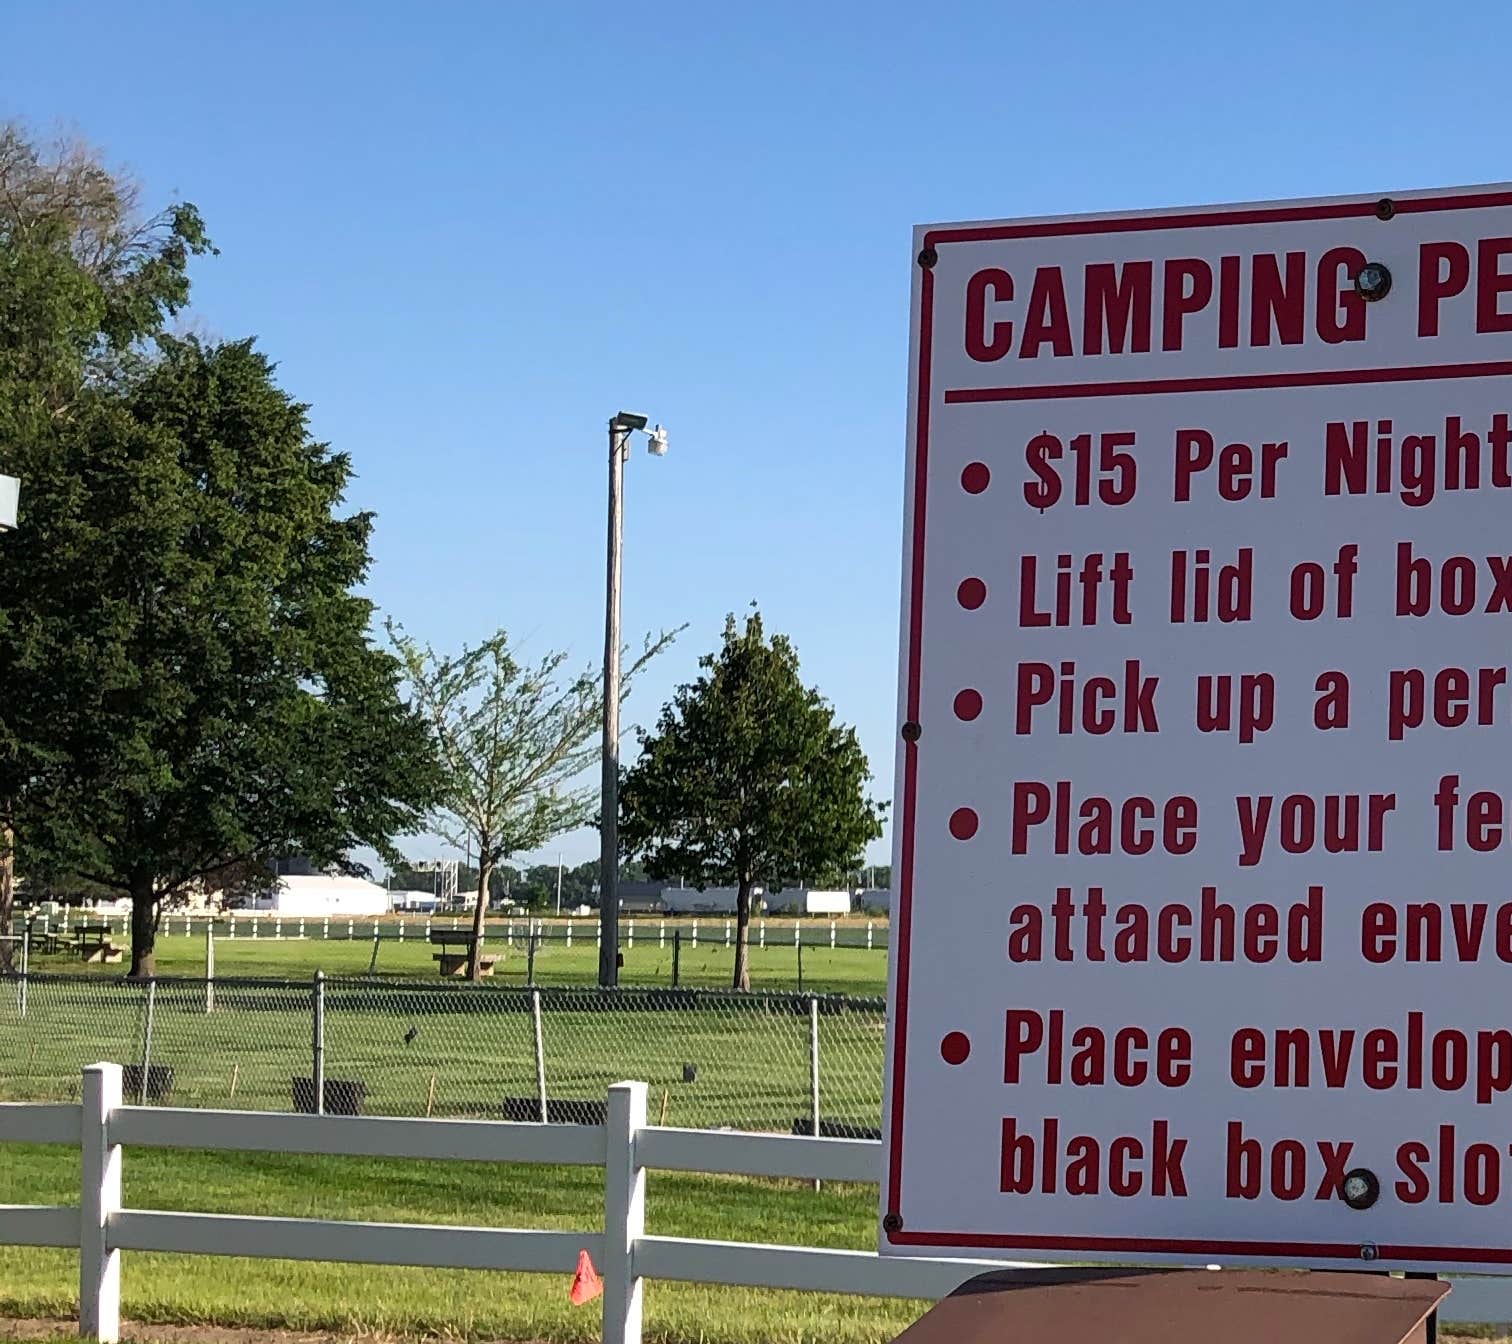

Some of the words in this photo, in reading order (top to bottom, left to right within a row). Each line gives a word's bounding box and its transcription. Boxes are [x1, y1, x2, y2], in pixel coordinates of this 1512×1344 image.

[966, 248, 1366, 361] CAMPING
[1024, 430, 1137, 514] $15
[1175, 429, 1287, 501] Per
[1326, 414, 1511, 506] Night
[1021, 553, 1132, 626] Lift
[1171, 549, 1252, 621] lid
[1290, 544, 1357, 619] of
[1016, 660, 1157, 733] Pick
[1197, 674, 1274, 741] up
[1314, 671, 1349, 728] a
[1013, 781, 1197, 854] Place
[1237, 794, 1395, 865] your
[1008, 886, 1323, 962] attached
[1004, 1009, 1191, 1087] Place
[1000, 1117, 1187, 1196] black
[1226, 1121, 1353, 1200] box
